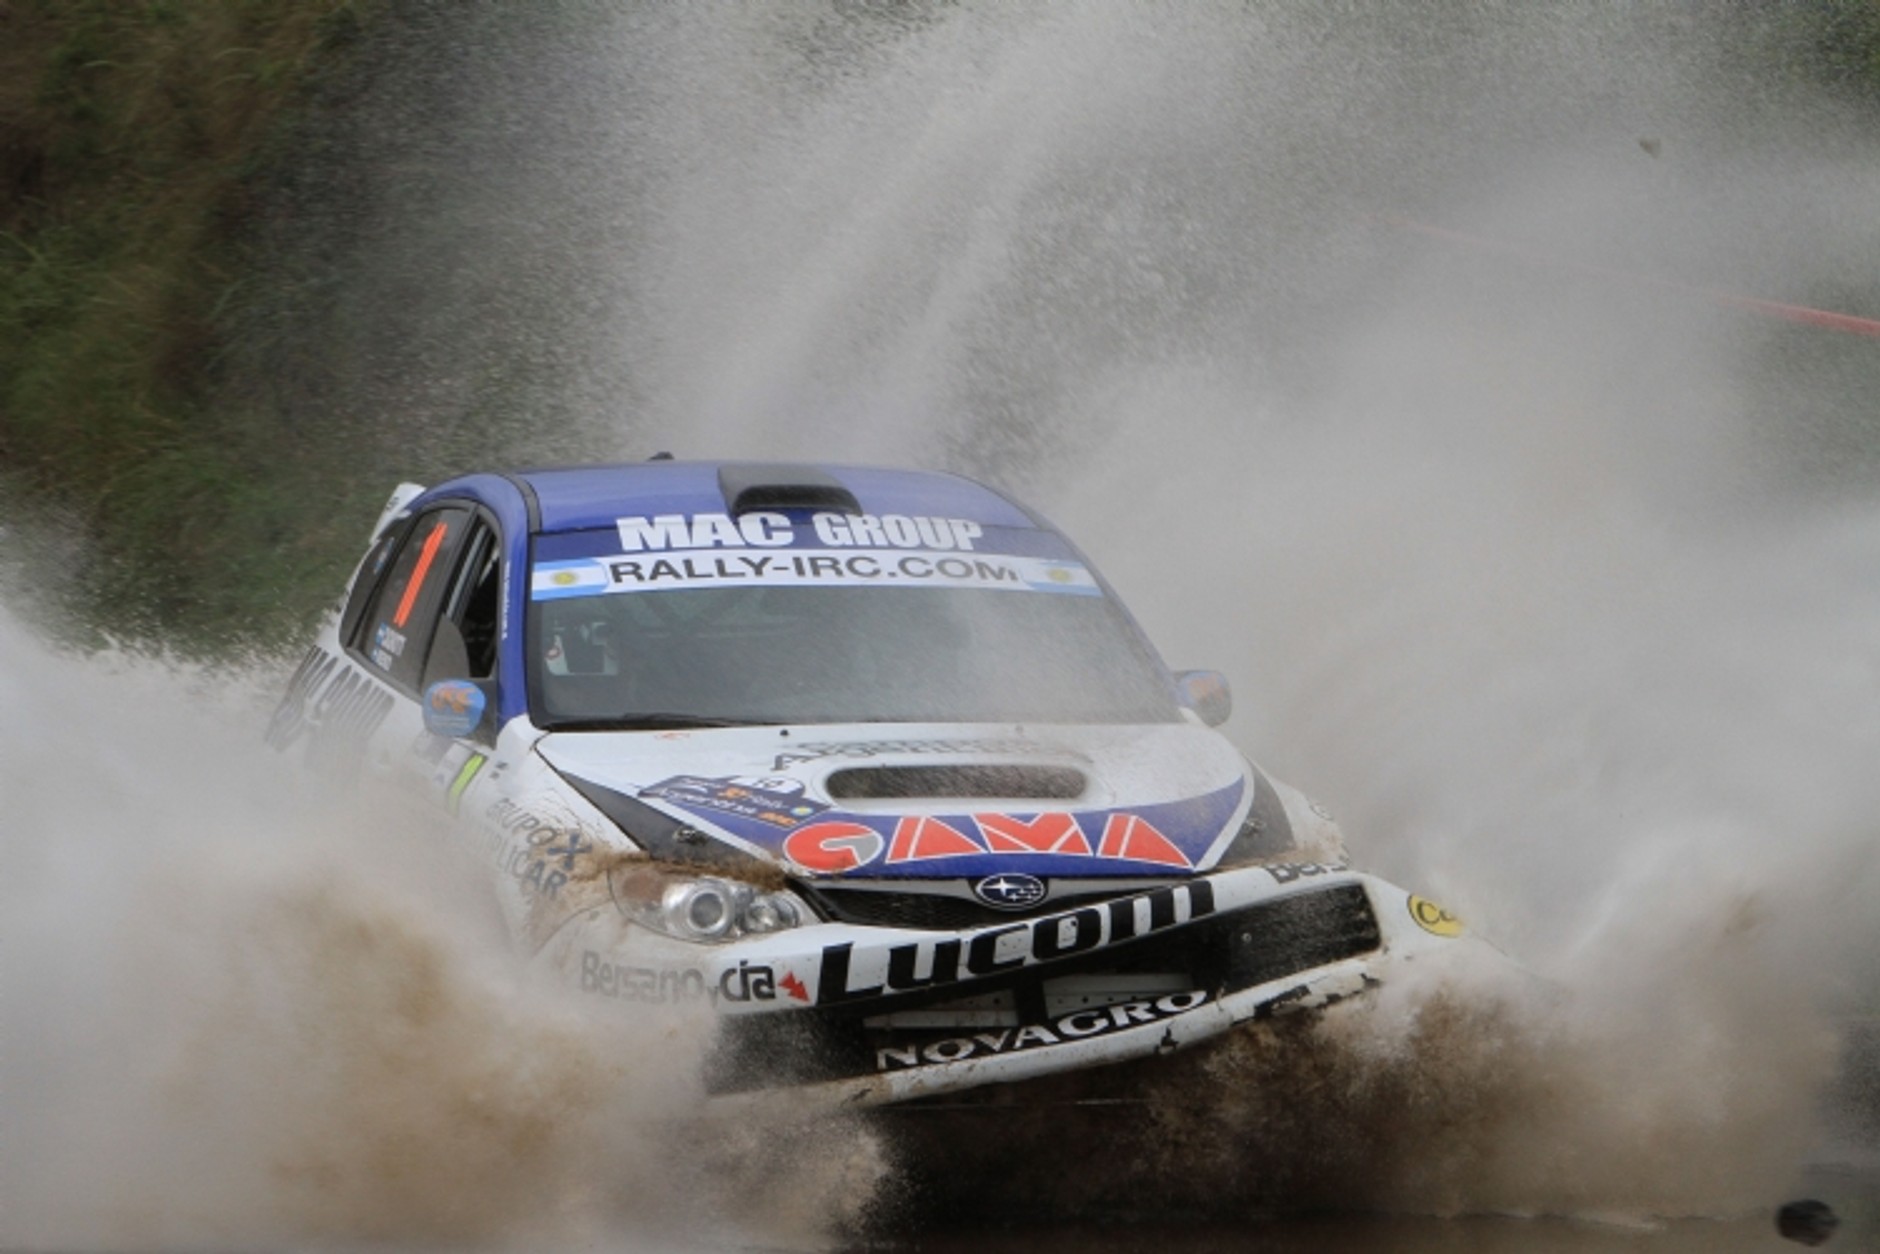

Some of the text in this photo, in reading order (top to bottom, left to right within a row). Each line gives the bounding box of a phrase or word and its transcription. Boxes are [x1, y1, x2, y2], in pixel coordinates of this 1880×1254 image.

[616, 512, 984, 551] MAC GROUP
[609, 556, 1018, 584] RALLY-IRC.COM
[719, 959, 777, 1002] cia
[876, 989, 1208, 1071] NOVAGRO
